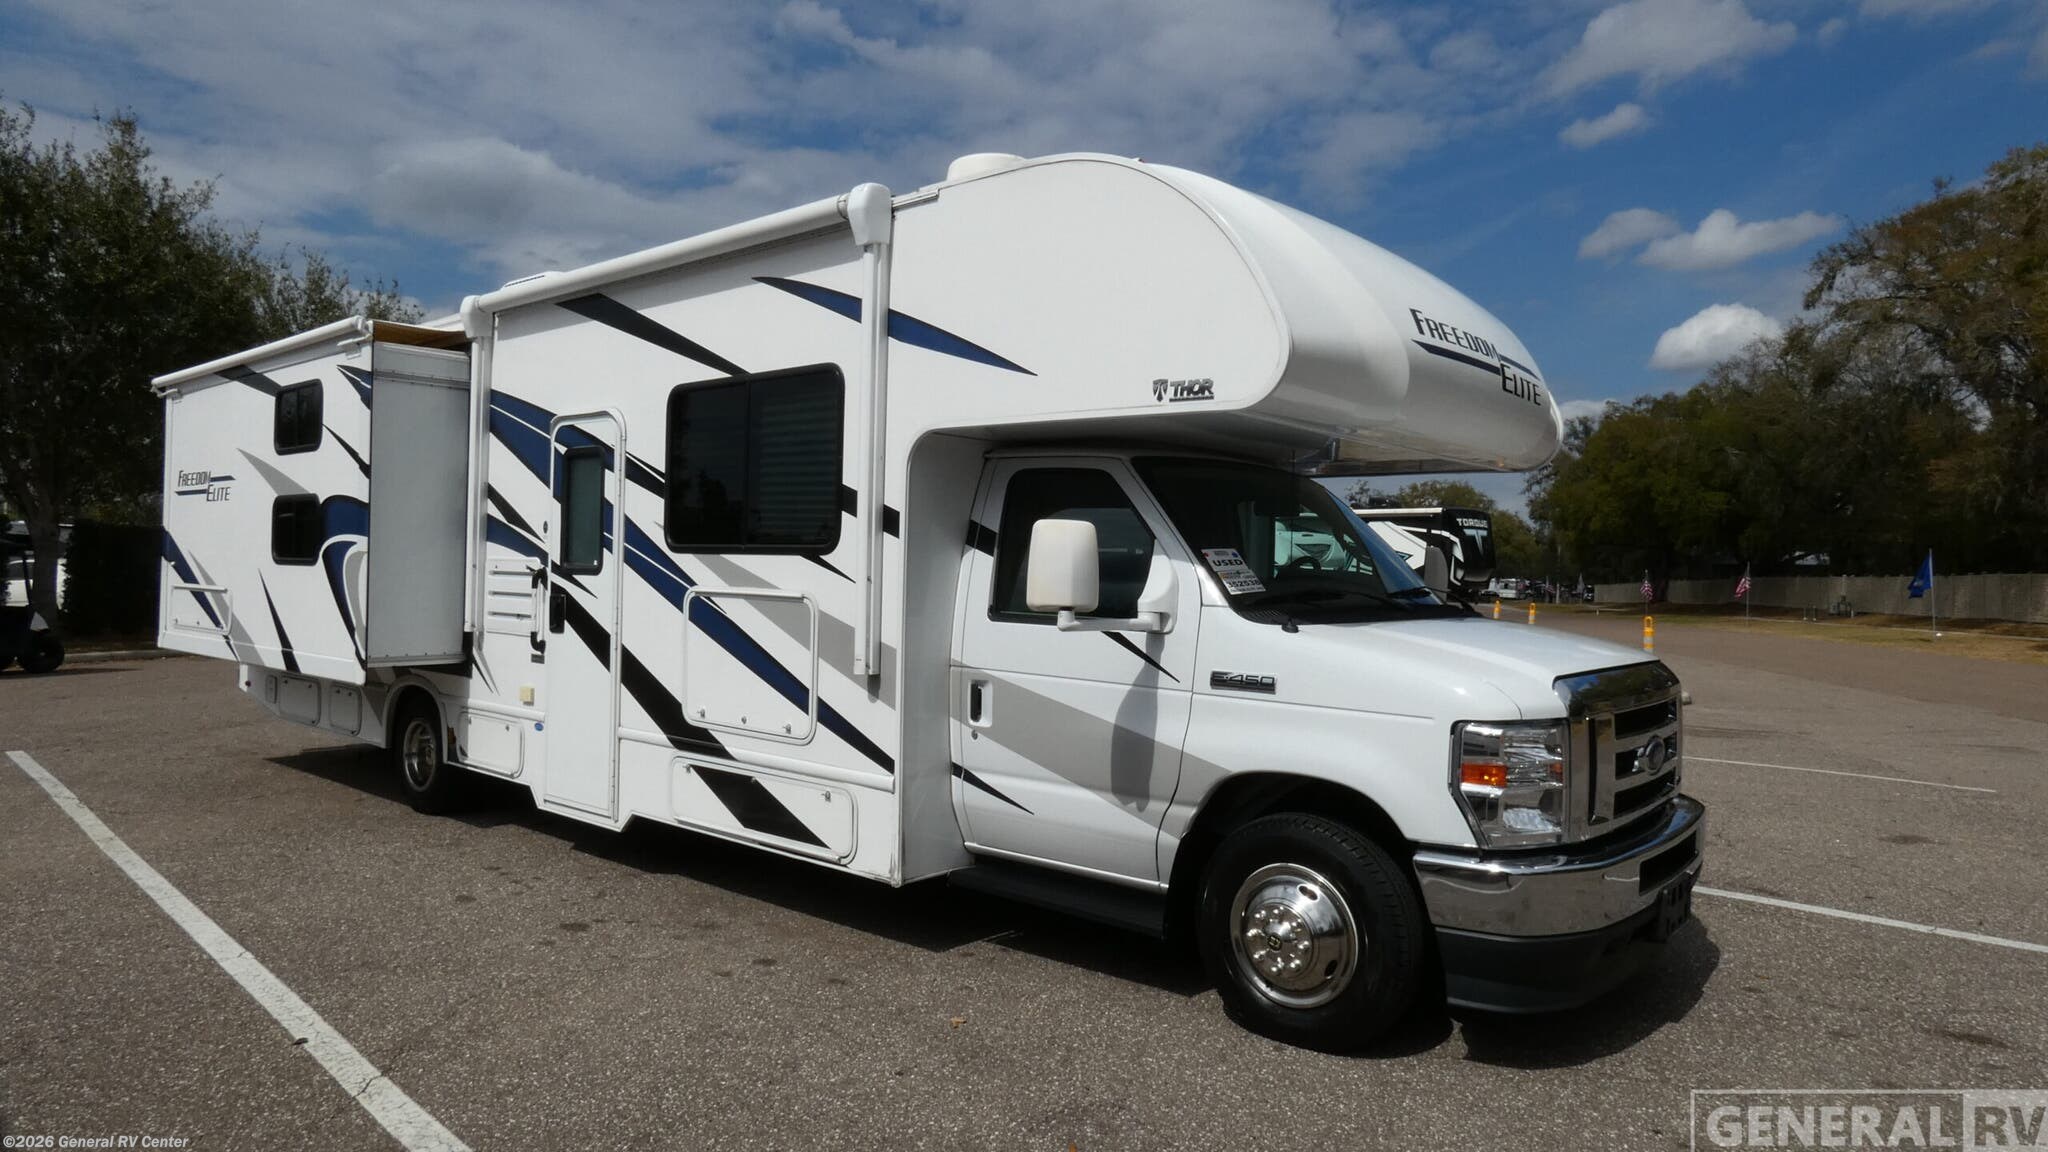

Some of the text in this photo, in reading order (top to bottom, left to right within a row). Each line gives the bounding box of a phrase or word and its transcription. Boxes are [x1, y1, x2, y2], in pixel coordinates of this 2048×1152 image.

[1409, 308, 1501, 361] FREEDOM
[1170, 379, 1214, 398] THOR
[1500, 363, 1542, 406] ELITE
[178, 470, 212, 487] FREEDOM
[206, 484, 231, 502] ELITE
[1456, 518, 1488, 528] TORQUE
[1212, 559, 1243, 567] USED
